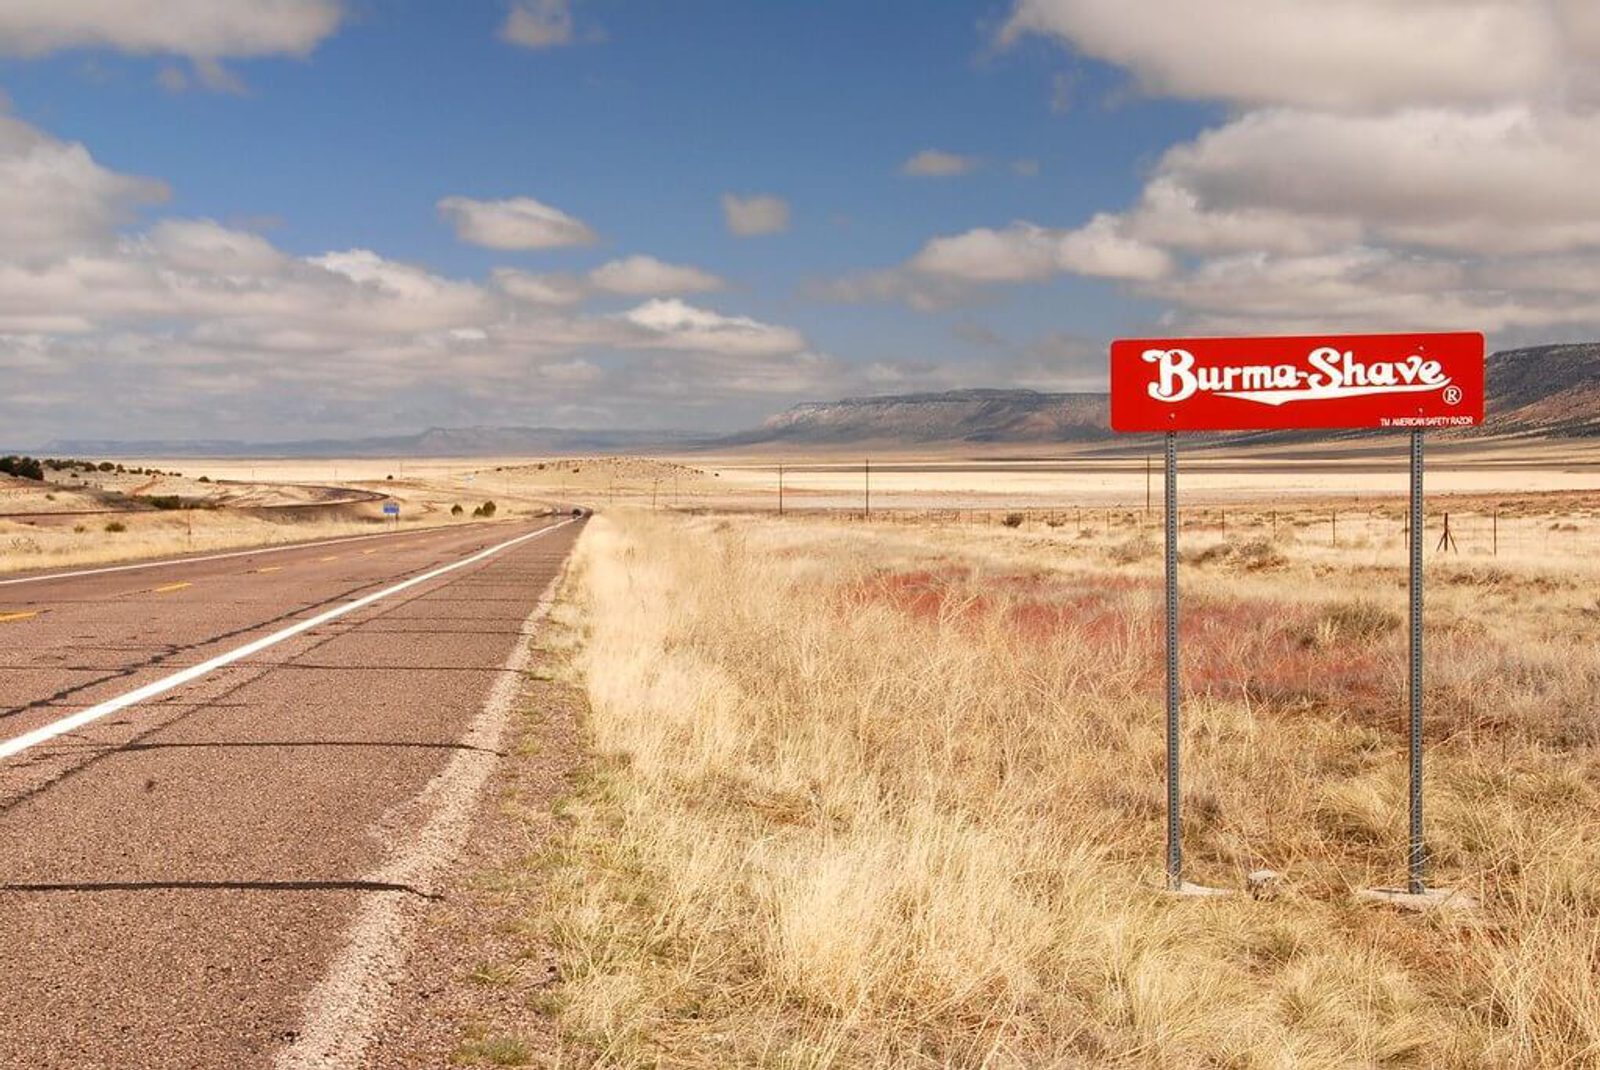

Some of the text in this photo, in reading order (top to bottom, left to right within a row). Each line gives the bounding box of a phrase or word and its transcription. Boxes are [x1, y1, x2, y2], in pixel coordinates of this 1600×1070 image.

[1141, 347, 1451, 405] Burma-Shave
[1392, 417, 1424, 426] AMERICAN
[1426, 416, 1449, 426] SAFETY
[1450, 416, 1473, 425] RAZOR
